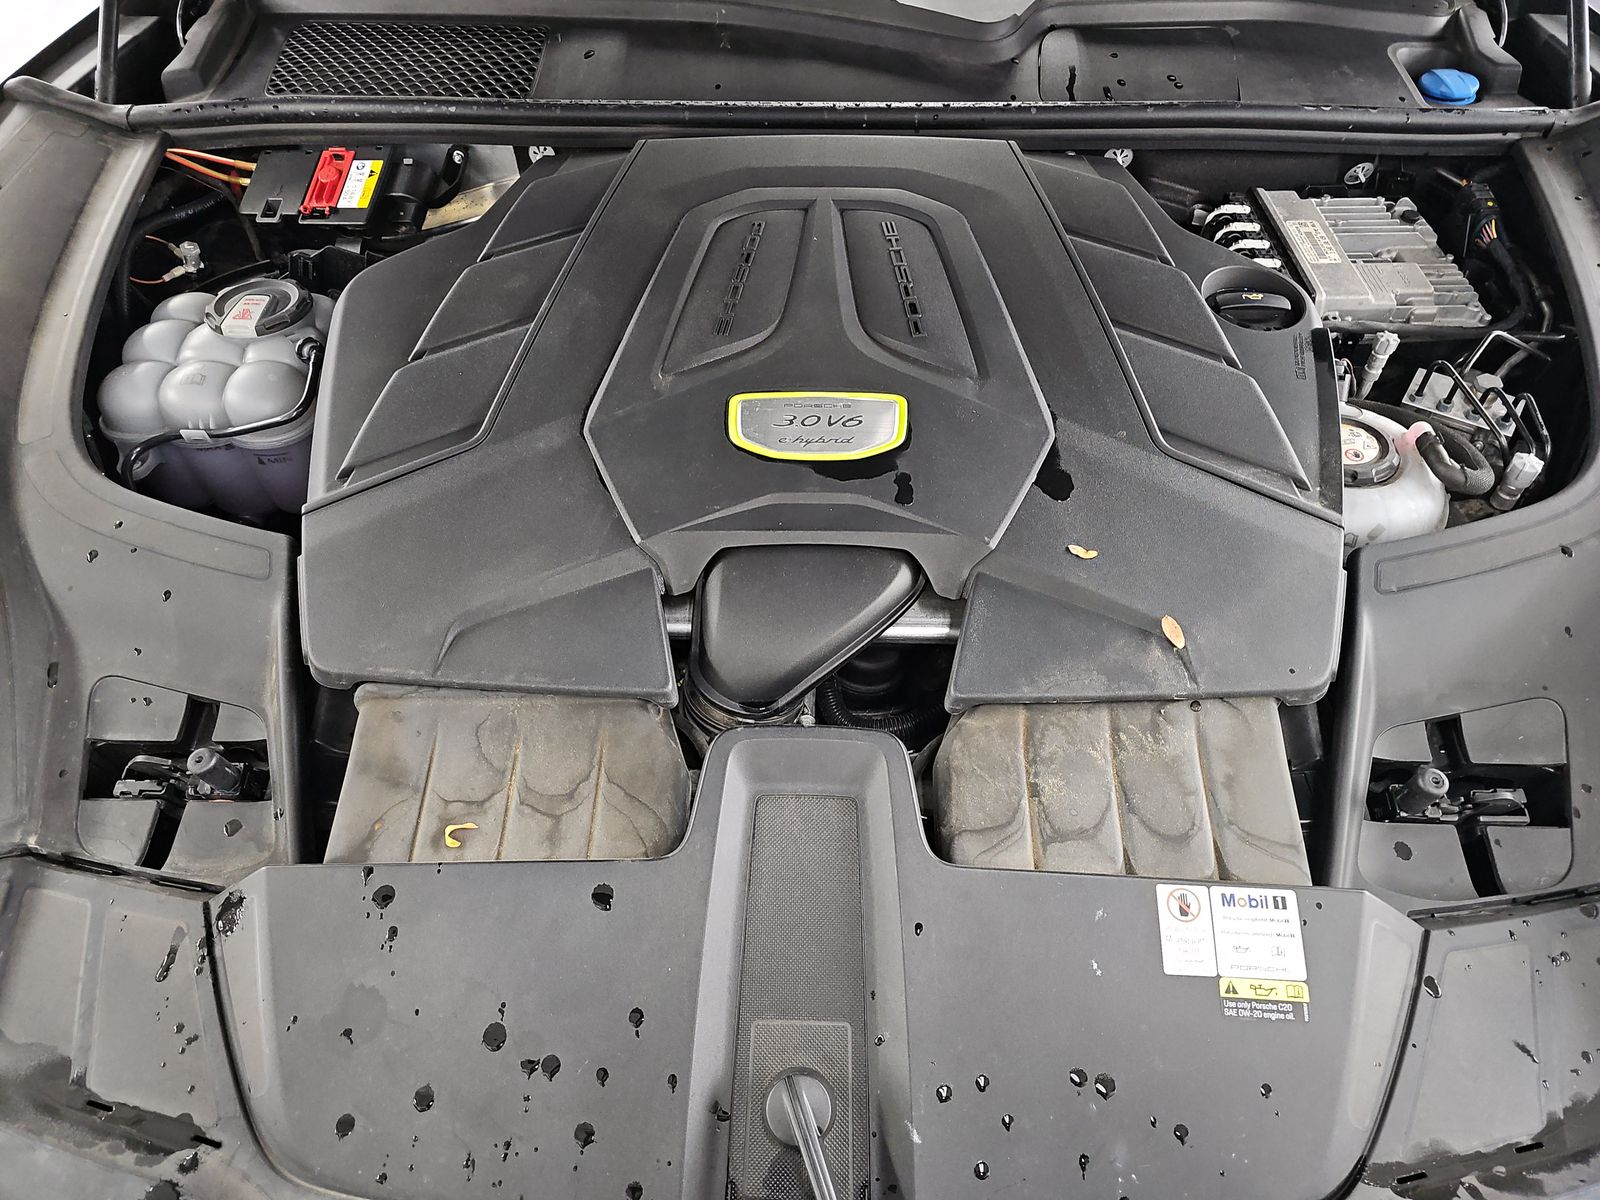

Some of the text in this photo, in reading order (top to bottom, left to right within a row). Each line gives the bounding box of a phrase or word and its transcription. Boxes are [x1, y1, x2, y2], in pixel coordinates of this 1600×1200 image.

[713, 220, 767, 336] PORSCHE
[881, 220, 928, 337] PORSCHE
[1221, 893, 1269, 909] Mobil
[1223, 1000, 1293, 1011] Use only Porsche C20
[1223, 1008, 1238, 1017] SAE
[1238, 1009, 1263, 1018] 0W-20
[1263, 1011, 1285, 1020] engine
[1285, 1011, 1296, 1020] oil.
